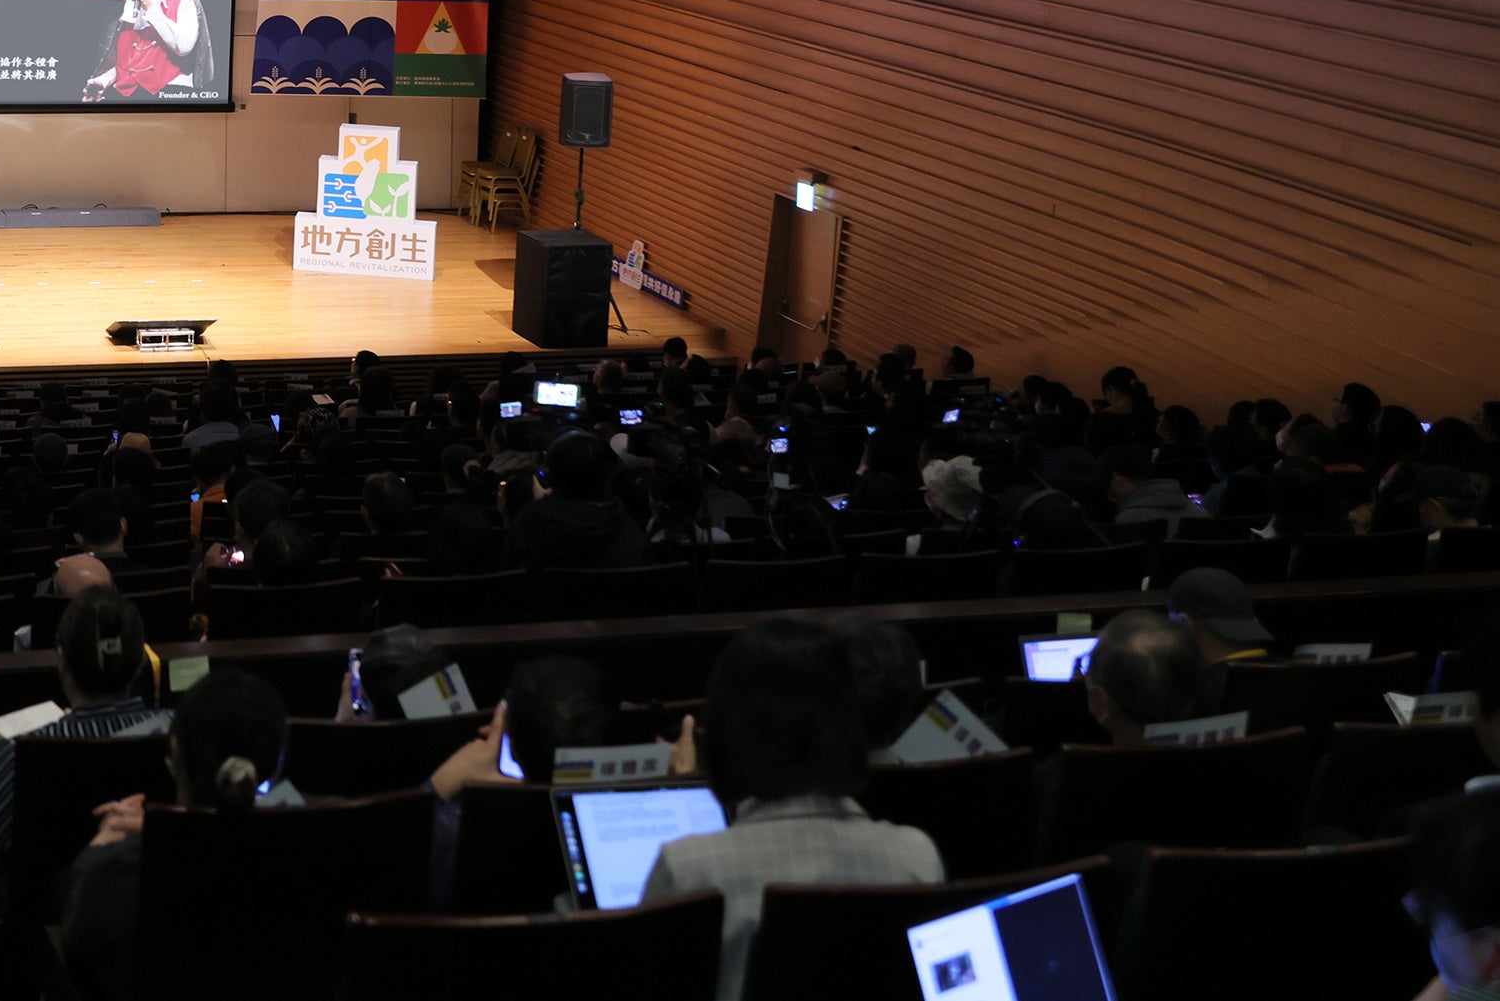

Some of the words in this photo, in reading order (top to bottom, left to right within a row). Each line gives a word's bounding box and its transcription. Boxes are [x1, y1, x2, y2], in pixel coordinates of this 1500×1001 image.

[158, 91, 190, 99] Founder
[191, 91, 198, 99] &
[200, 91, 219, 99] CEO
[301, 225, 428, 263] 地方創生
[300, 258, 346, 269] REGIONAL
[350, 261, 428, 274] REVITALIZATION
